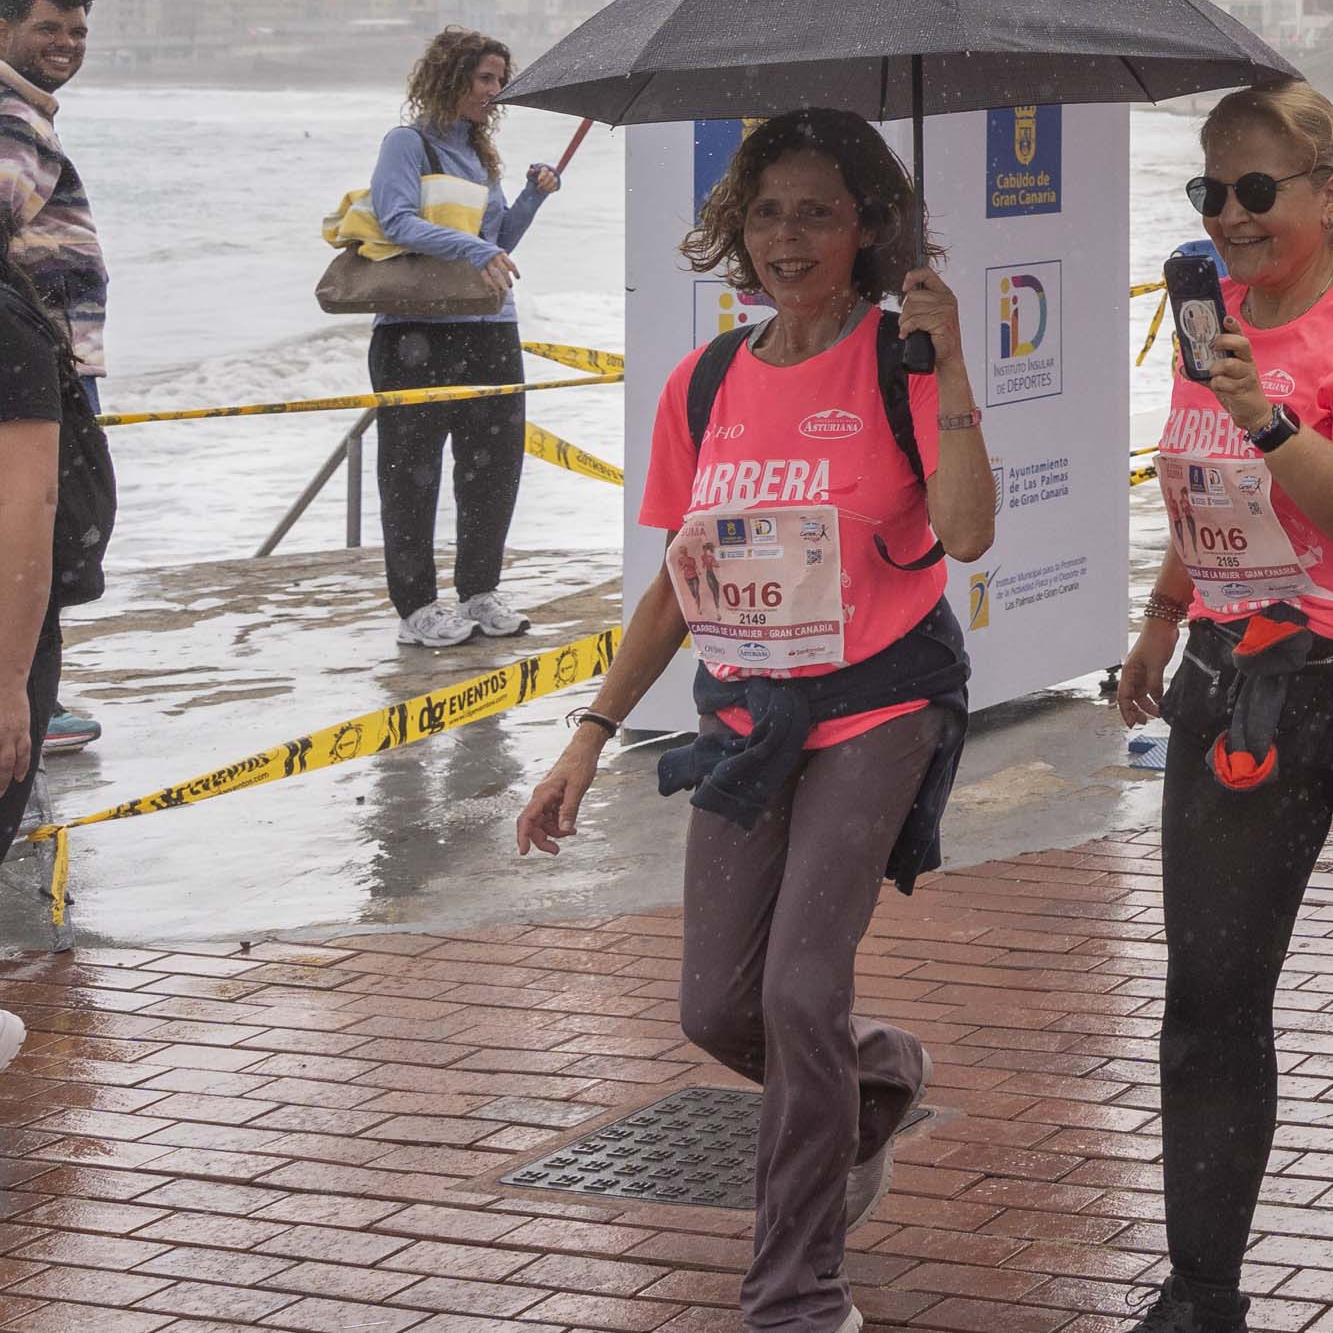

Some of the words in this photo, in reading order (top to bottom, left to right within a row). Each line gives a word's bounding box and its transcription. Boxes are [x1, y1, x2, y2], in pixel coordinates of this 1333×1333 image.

[997, 173, 1037, 189] Cabildo
[1038, 171, 1051, 186] de
[992, 191, 1018, 207] Gran
[1020, 187, 1056, 206] Canaria
[805, 421, 859, 432] ASTURIANA
[1009, 458, 1068, 479] Ayuntamiento
[1010, 482, 1019, 494] de
[1024, 479, 1036, 490] Las
[1041, 471, 1068, 487] Palmas
[1010, 497, 1019, 508] de
[1021, 492, 1039, 506] Gran
[1041, 485, 1068, 500] Canaria
[1200, 526, 1248, 551] 016
[1216, 556, 1240, 567] 2185
[723, 582, 782, 608] 016
[739, 613, 766, 625] 2149
[692, 624, 721, 636] CARRERA
[722, 627, 728, 636] DE
[730, 628, 738, 636] LA
[738, 629, 762, 638] MUJER
[769, 630, 792, 638] GRAN
[795, 625, 833, 636] CANARIA
[418, 696, 446, 734] dg
[449, 671, 508, 717] EVENTOS
